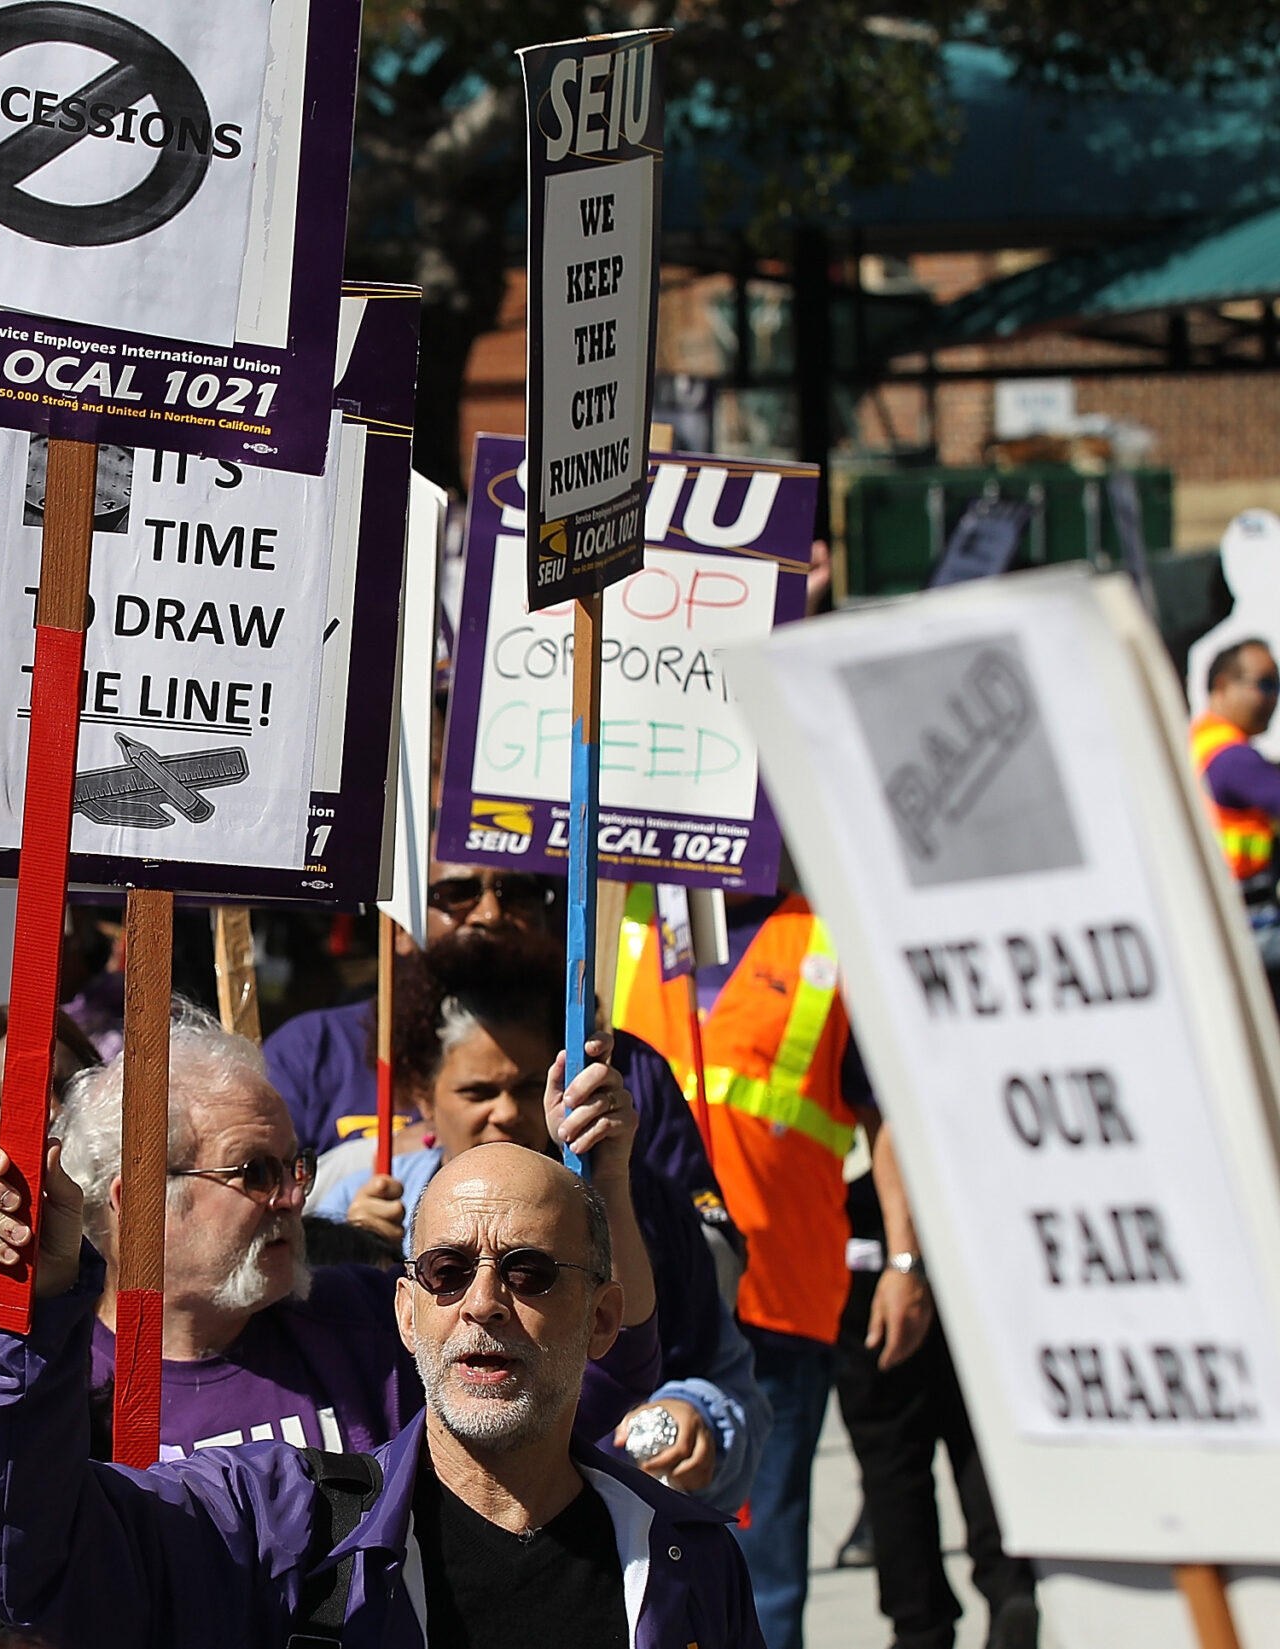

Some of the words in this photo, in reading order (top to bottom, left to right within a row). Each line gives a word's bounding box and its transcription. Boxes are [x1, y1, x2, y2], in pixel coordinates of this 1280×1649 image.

[547, 43, 654, 162] SEIU
[580, 193, 616, 239] WE
[566, 254, 624, 305] KEEP
[34, 331, 116, 355] Employees
[121, 343, 228, 369] International
[232, 356, 281, 376] Union
[574, 319, 617, 366] THE
[42, 394, 80, 412] Strong
[81, 401, 104, 413] and
[107, 404, 147, 419] United
[150, 408, 162, 420] in
[164, 411, 217, 427] Northern
[218, 418, 272, 436] California
[163, 369, 279, 418] 1021
[571, 380, 618, 431] CITY
[549, 437, 631, 498] RUNNING
[144, 517, 279, 571] TIME
[573, 519, 616, 561] LOCAL
[618, 507, 639, 545] 1021
[537, 557, 567, 587] SEIU
[114, 594, 286, 650] DRAW
[139, 674, 273, 728] LINE!
[465, 829, 532, 855] SEIU
[547, 820, 662, 858] LCAL
[671, 832, 748, 866] 1021
[901, 940, 1002, 1019] WE
[1004, 923, 1158, 1012] PAID
[1002, 1069, 1138, 1149] OUR
[1029, 1206, 1185, 1286] FAIR
